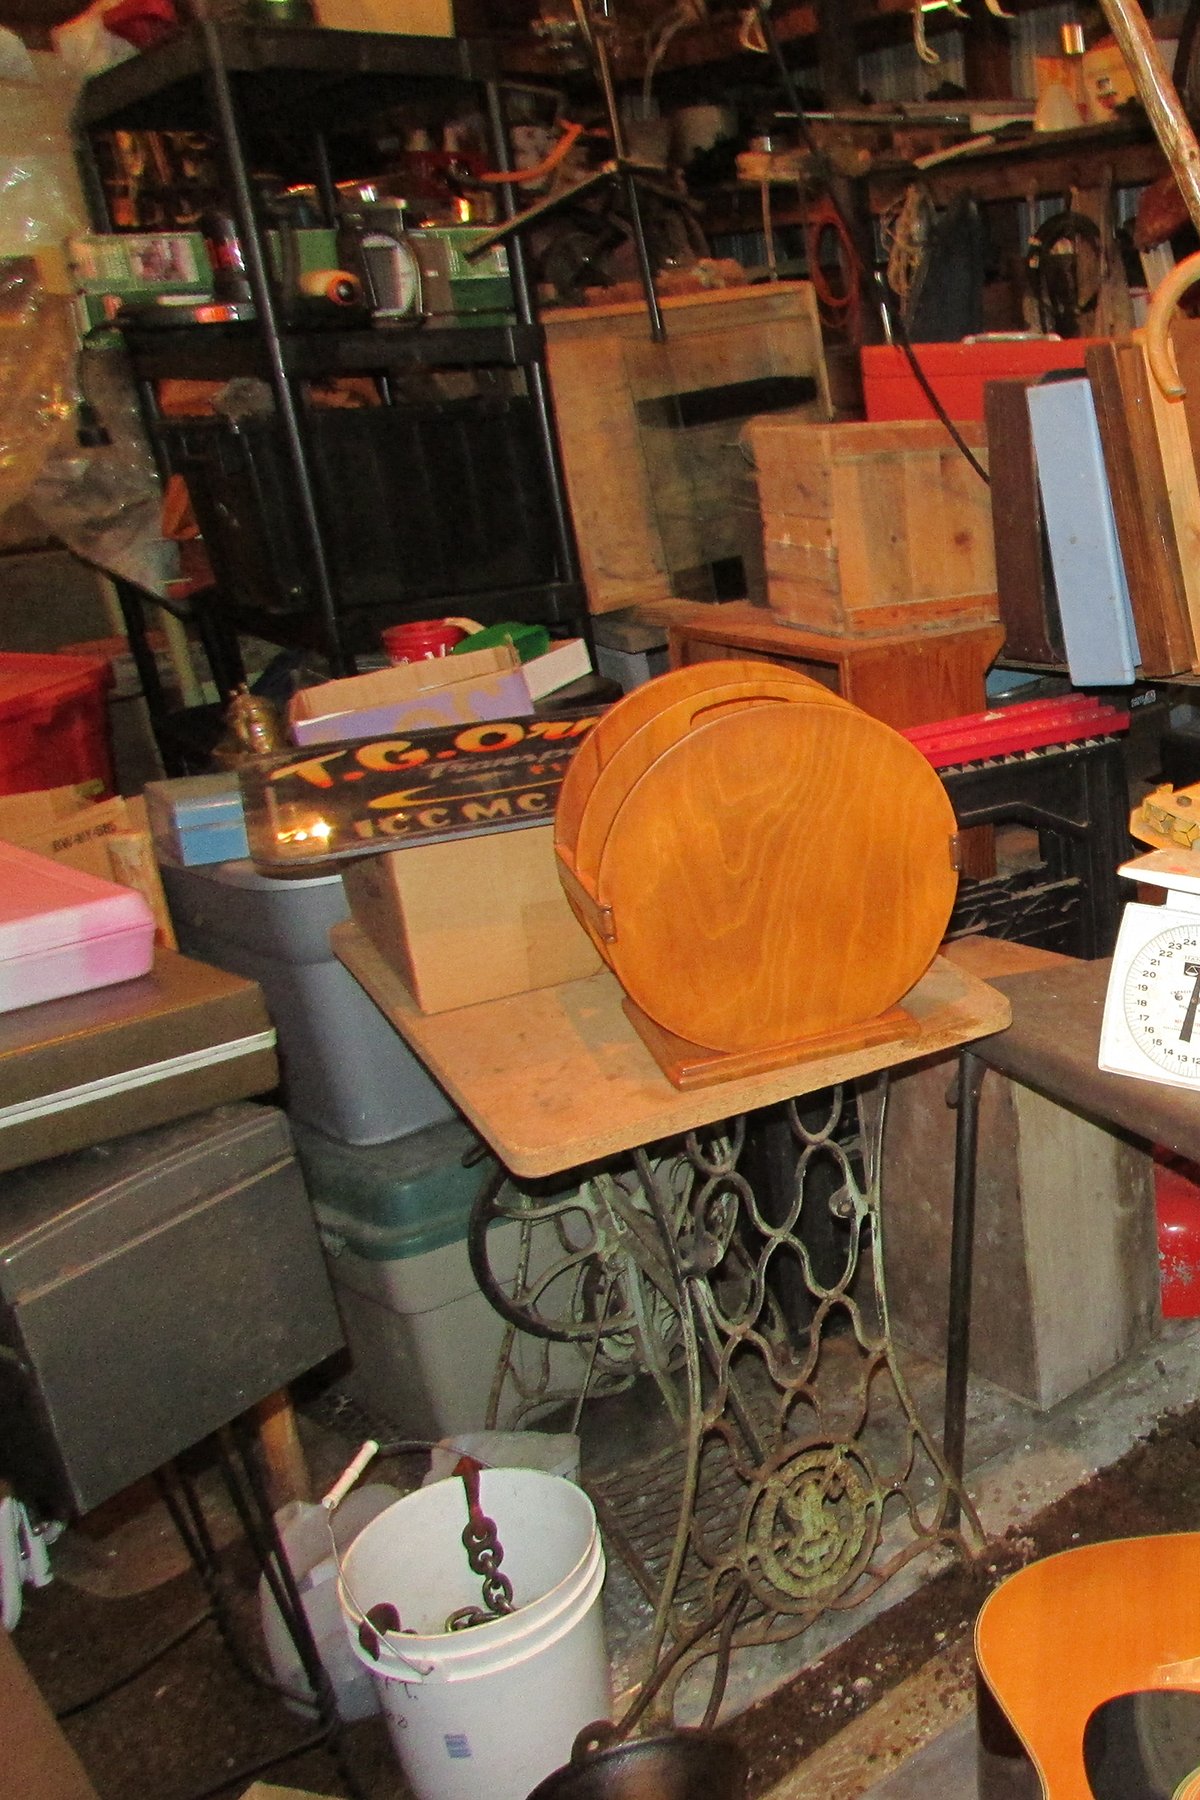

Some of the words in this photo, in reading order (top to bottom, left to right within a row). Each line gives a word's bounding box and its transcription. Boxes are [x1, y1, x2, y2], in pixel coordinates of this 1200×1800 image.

[1168, 941, 1183, 951] 23
[1183, 938, 1197, 947] 24
[1159, 949, 1173, 958] 22
[1150, 958, 1161, 966] 21
[1142, 970, 1157, 979] 20
[1137, 983, 1149, 992] 19
[1136, 999, 1147, 1007] 18
[1144, 1026, 1155, 1034] 16
[1152, 1038, 1163, 1046] 15
[1163, 1048, 1174, 1056] 14
[1177, 1054, 1188, 1063] 13
